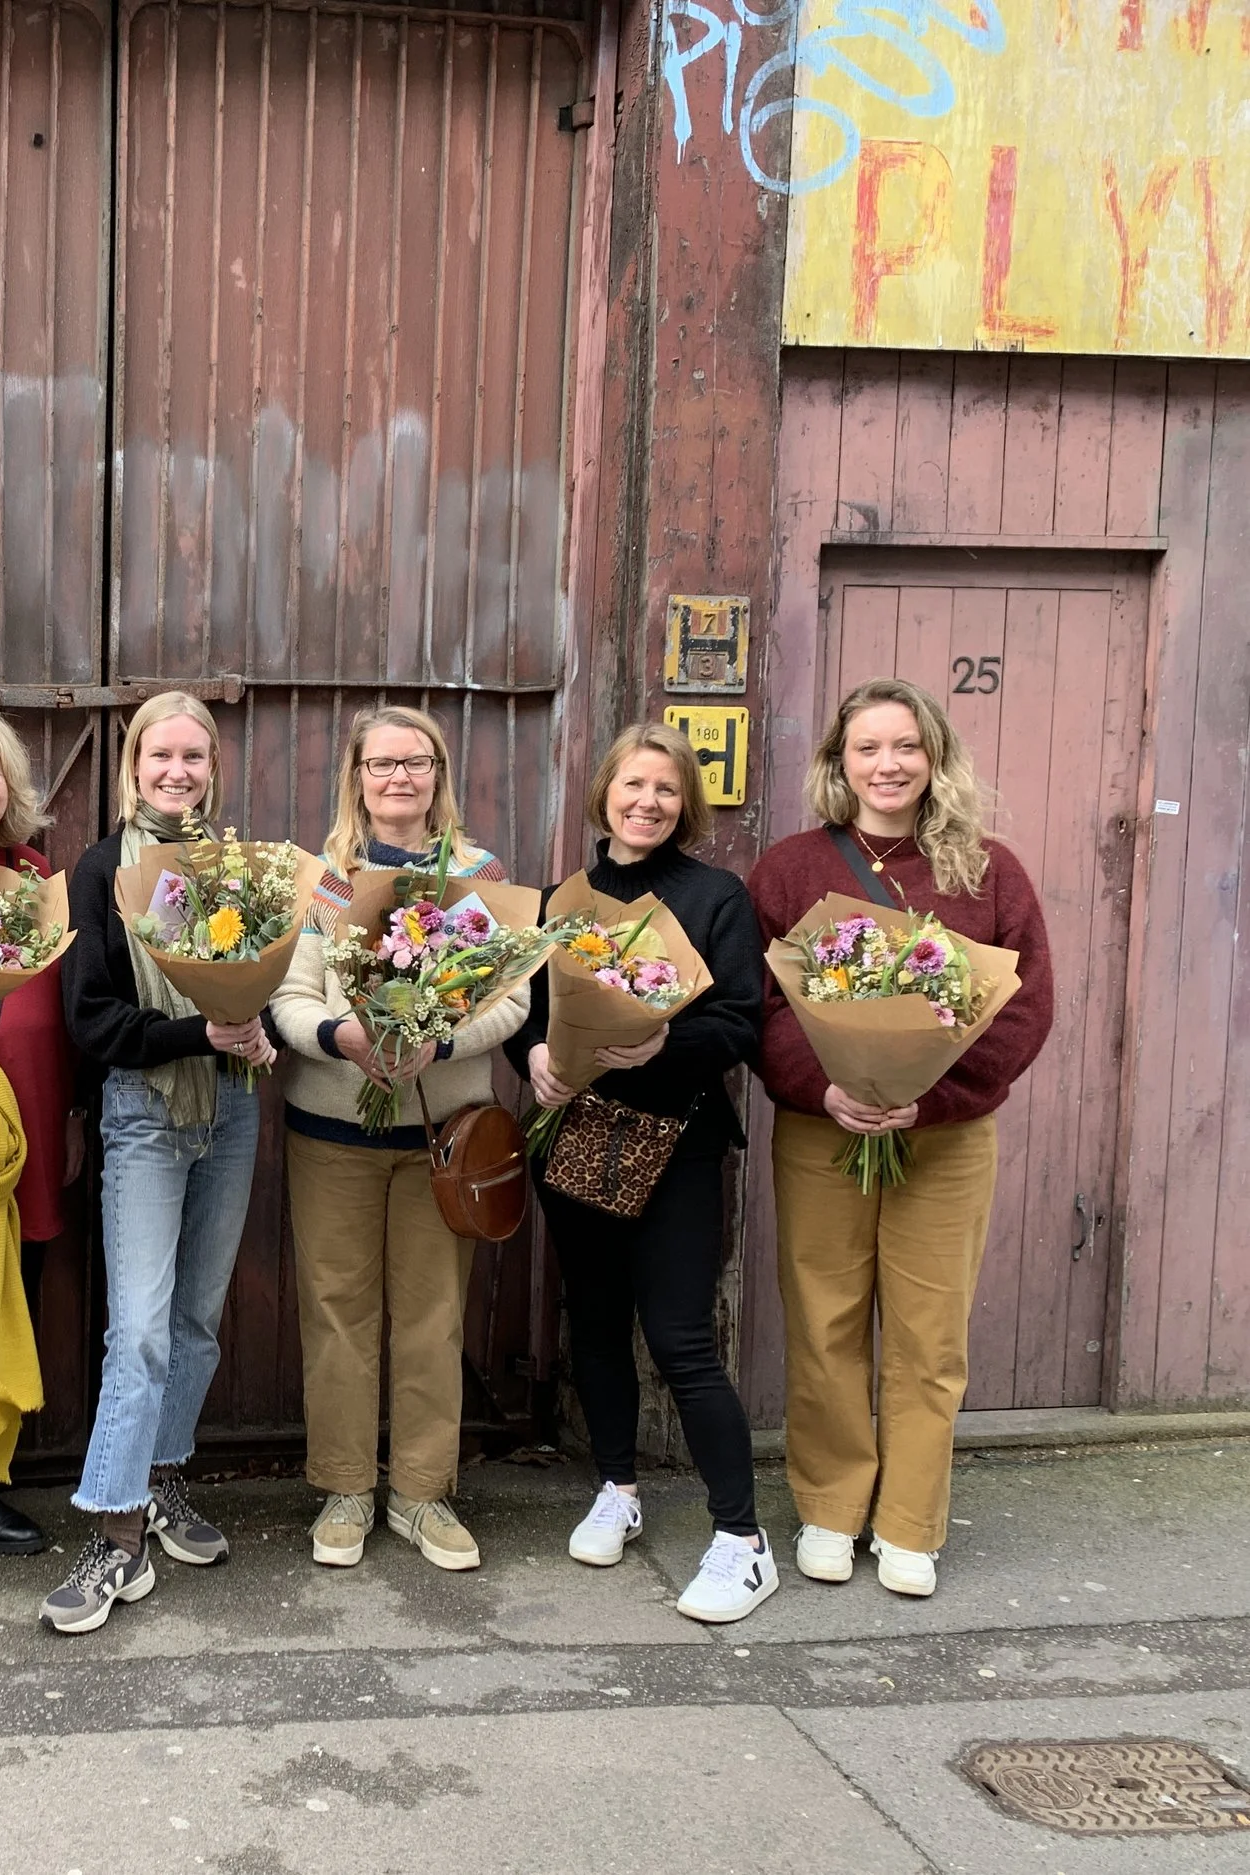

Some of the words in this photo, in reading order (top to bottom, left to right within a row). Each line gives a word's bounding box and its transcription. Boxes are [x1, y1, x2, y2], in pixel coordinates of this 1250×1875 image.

[702, 612, 717, 634] 7
[700, 655, 715, 678] 3
[952, 656, 1001, 694] 25
[696, 728, 719, 741] 180
